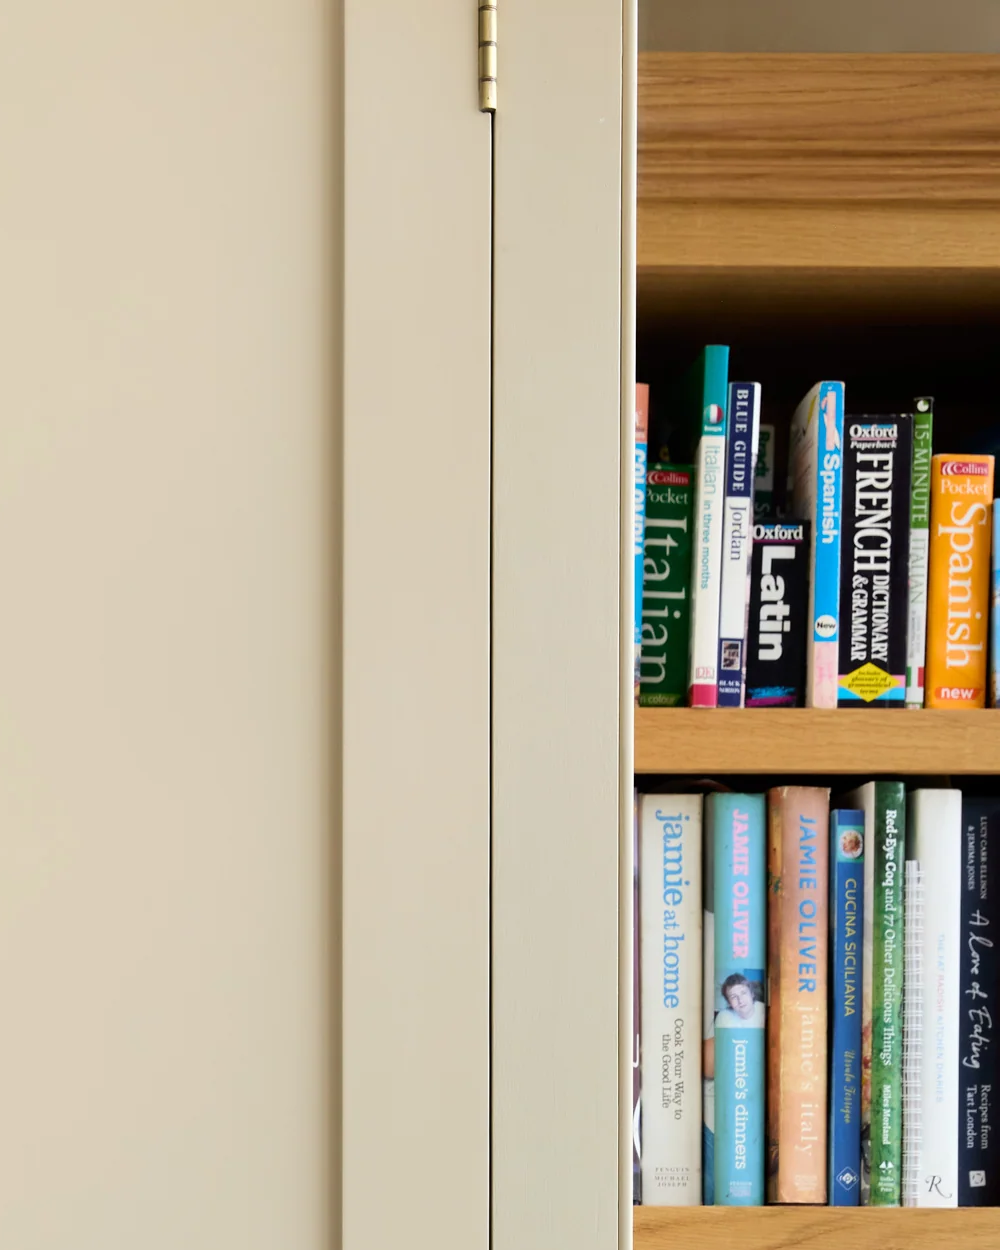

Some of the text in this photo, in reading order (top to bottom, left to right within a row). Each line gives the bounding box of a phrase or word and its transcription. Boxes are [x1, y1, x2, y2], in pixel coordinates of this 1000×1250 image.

[732, 388, 749, 492] BLUE GUIDE
[849, 424, 898, 439] Oxford
[850, 440, 897, 450] Paperback
[654, 472, 689, 485] Collins
[704, 444, 720, 495] Italian
[820, 453, 840, 544] Spanish
[911, 423, 930, 522] 15-MINUTE
[941, 479, 988, 495] Pocket
[954, 463, 988, 475] Collins
[702, 514, 713, 545] three
[703, 499, 715, 512] in
[730, 504, 747, 561] Jordan
[753, 524, 803, 541] Oxford
[853, 451, 893, 573] FRENCH
[700, 547, 711, 590] months
[909, 537, 926, 605] ITALIAN
[938, 500, 987, 669] Spanish
[641, 517, 688, 684] Italian
[758, 545, 796, 661] Latin
[816, 622, 836, 630] New
[851, 575, 869, 662] & GRAMMAR
[871, 574, 891, 662] DICTIONARY
[941, 688, 974, 699] new
[967, 833, 975, 864] JEMIMA
[980, 816, 988, 838] LUCY
[732, 808, 749, 960] JAMIE OLIVER
[798, 814, 817, 993] JAMIE OLIVER
[967, 865, 975, 891] JONES
[655, 809, 690, 1009] jamie at home
[880, 809, 898, 1066] Red-Eye Coq and 77 Other Delicious Things
[969, 909, 990, 926] A
[844, 878, 857, 1017] CUCINA SICILIANA
[936, 974, 944, 1012] RADISH
[965, 981, 988, 1000] of
[662, 1034, 671, 1109] the Good Life
[672, 1018, 684, 1120] Cook Your Way to
[732, 1039, 749, 1100] jamie's
[794, 1002, 820, 1157] jamie's italy
[935, 1062, 943, 1103] DIARIES
[734, 1104, 749, 1170] dinners
[883, 1084, 891, 1145] Miles Morland
[966, 1084, 977, 1149] Tart London
[979, 1084, 991, 1150] Recipes from
[925, 1175, 952, 1199] R
